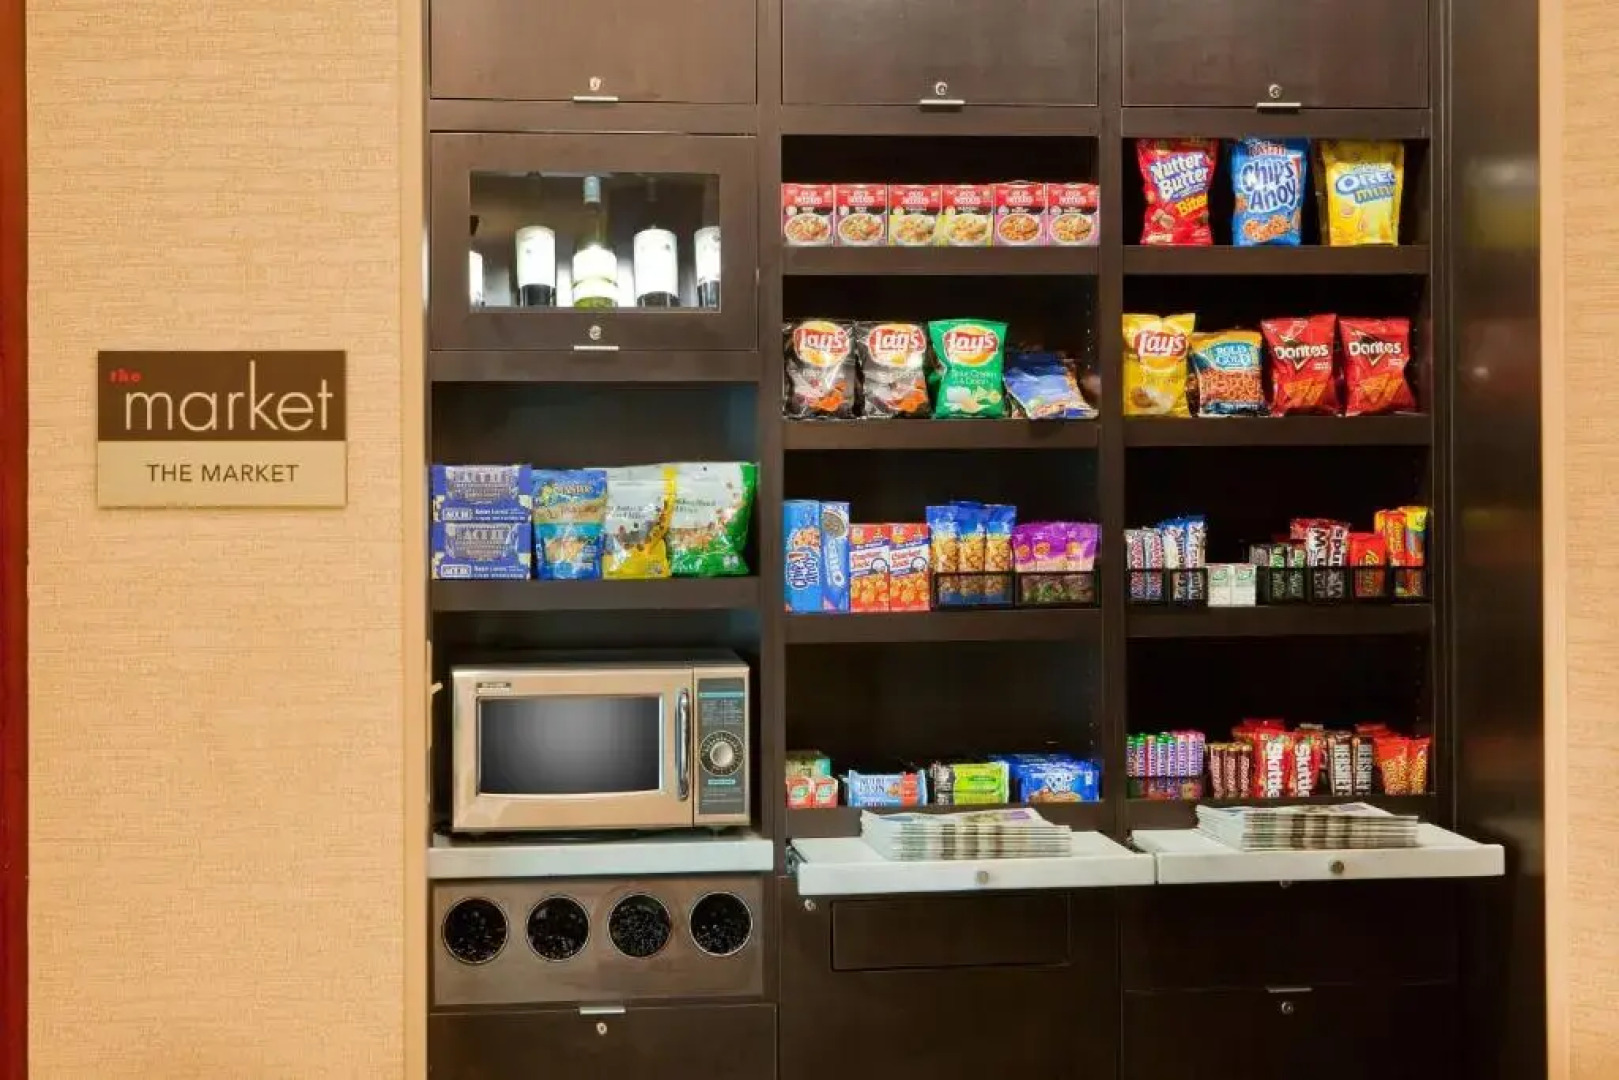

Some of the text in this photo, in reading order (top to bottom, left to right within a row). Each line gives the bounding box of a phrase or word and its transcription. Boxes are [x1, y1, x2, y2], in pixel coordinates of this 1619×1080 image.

[1150, 152, 1203, 181] Nutter
[1242, 160, 1294, 192] Chips
[1157, 166, 1208, 202] Butter
[1274, 344, 1328, 359] Doritos
[1349, 341, 1401, 355] Doritos
[109, 369, 142, 382] the
[125, 360, 333, 431] market
[147, 465, 299, 482] THE MARKET
[1266, 740, 1284, 797] Skittle
